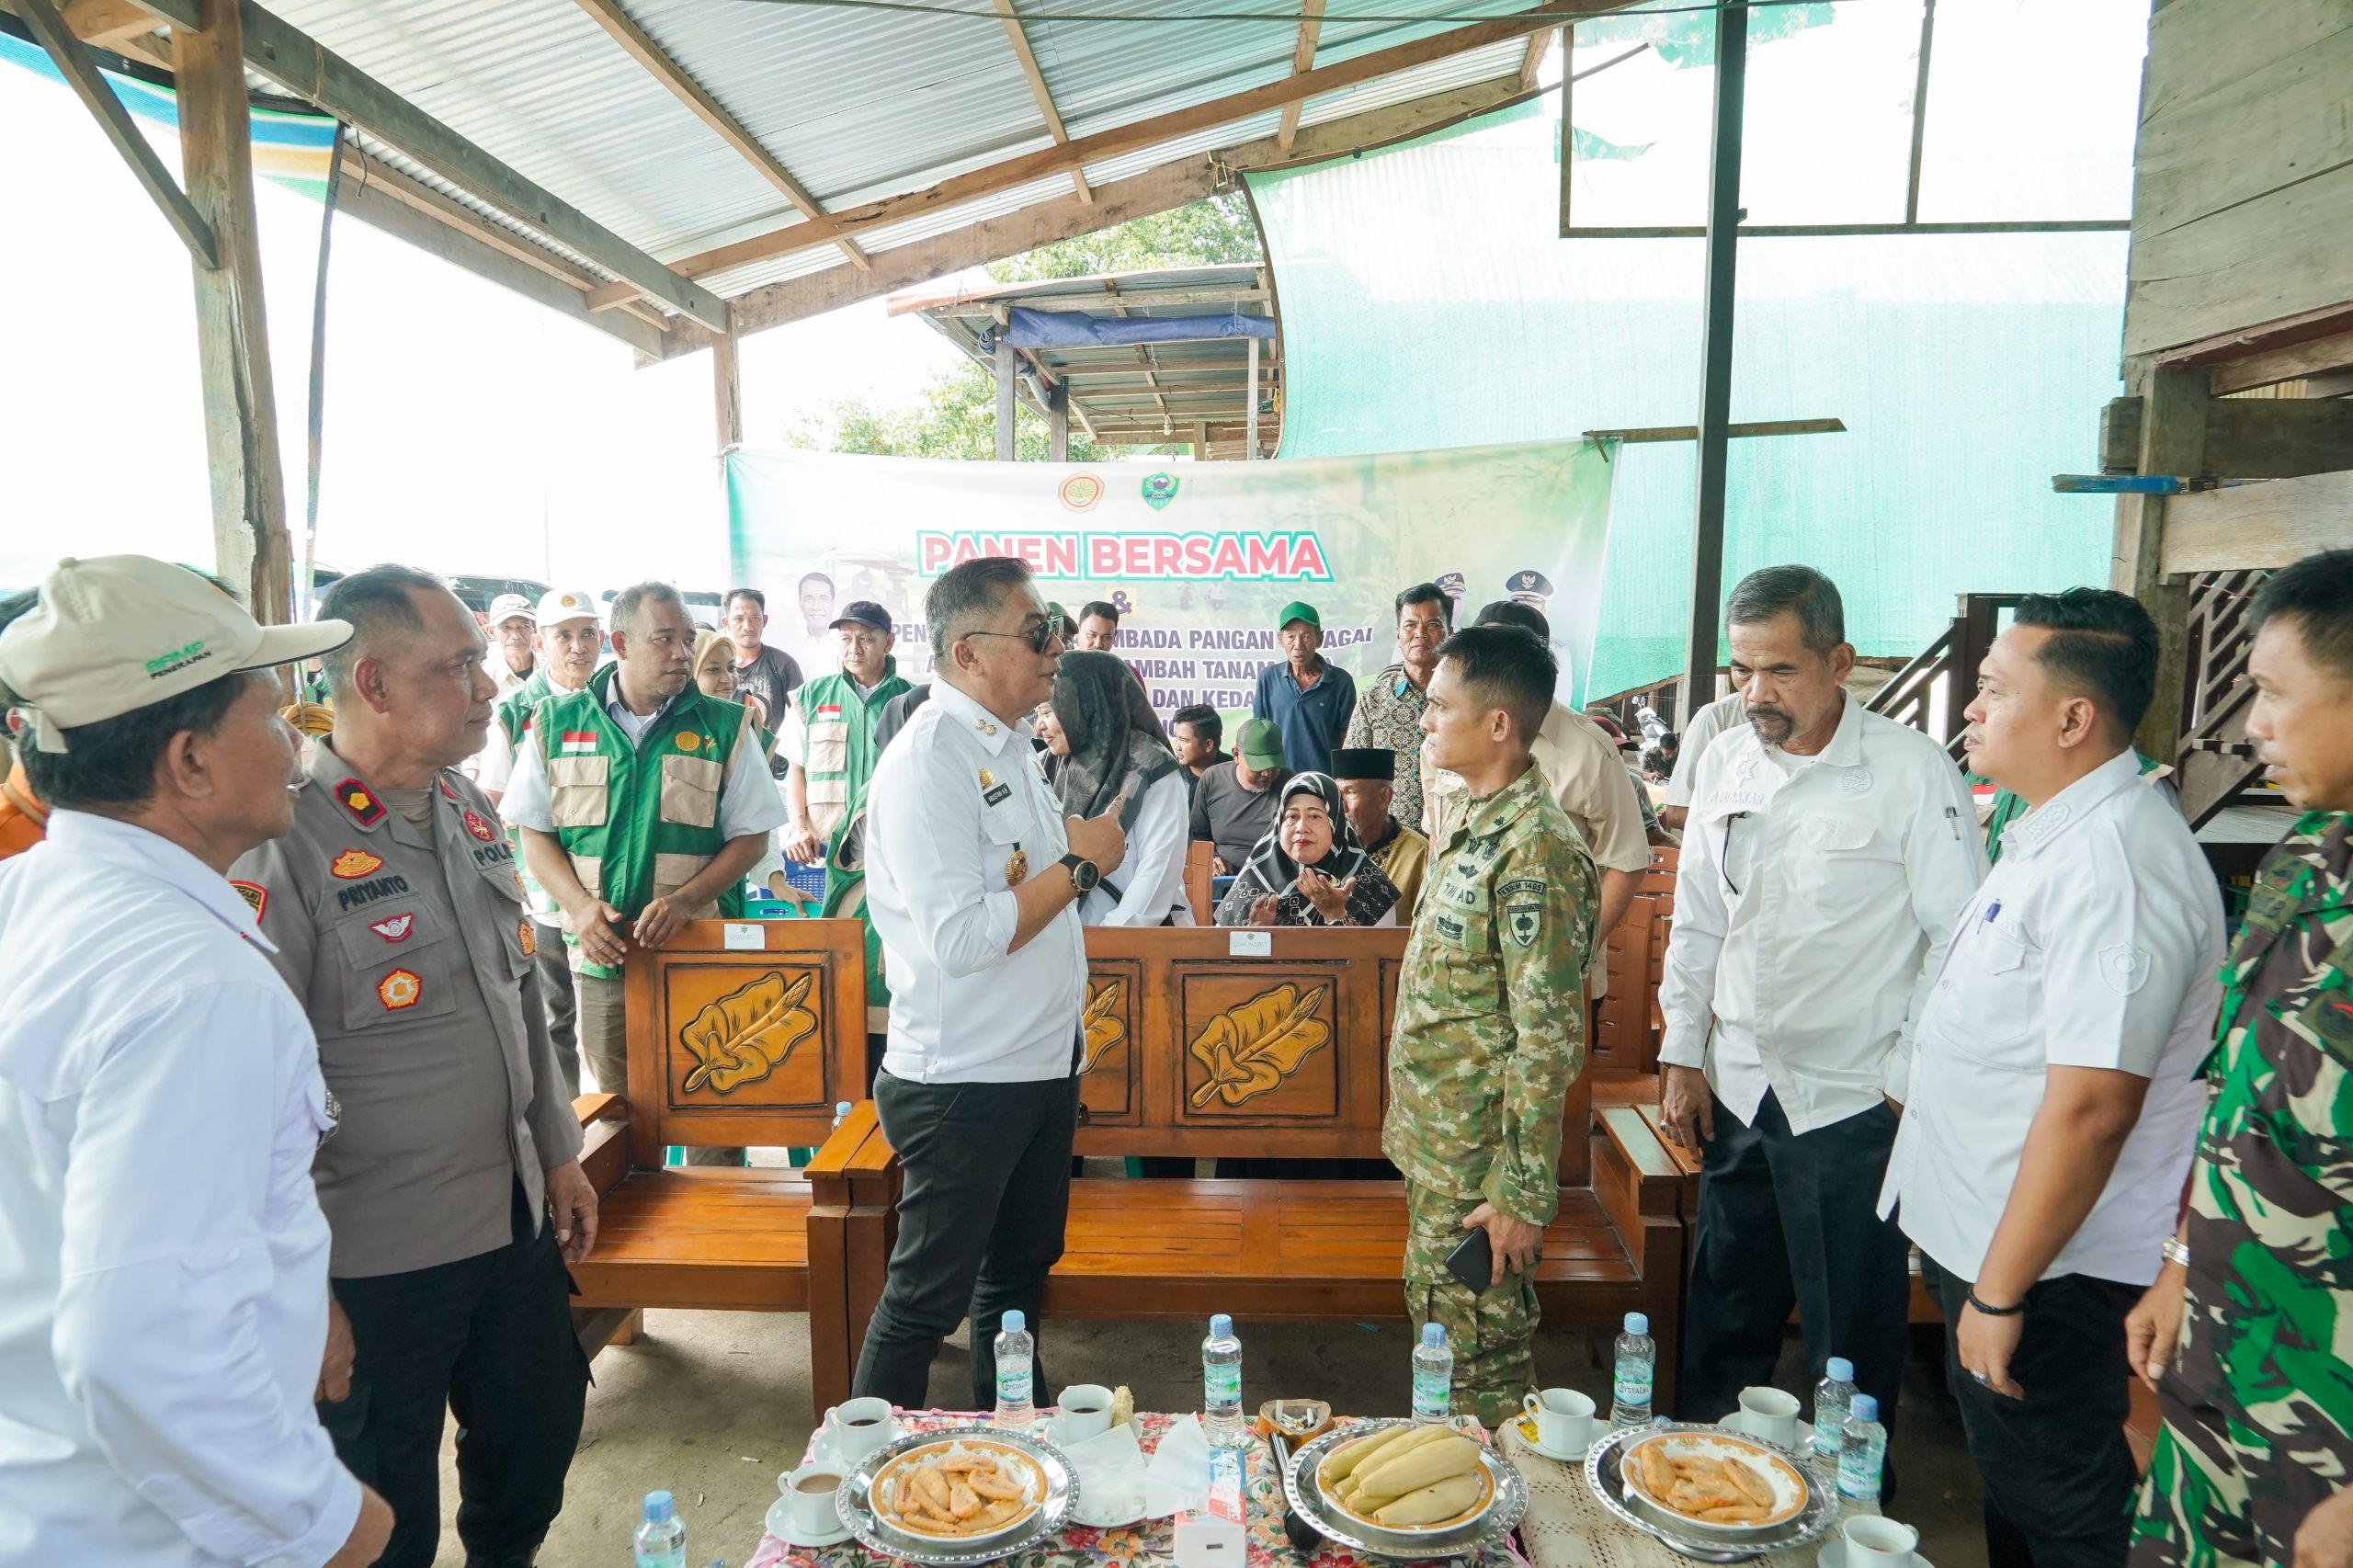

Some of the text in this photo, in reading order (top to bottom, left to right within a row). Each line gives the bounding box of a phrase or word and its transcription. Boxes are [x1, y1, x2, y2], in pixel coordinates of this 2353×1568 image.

[923, 535, 1327, 575] PANEN BERSAMA
[1110, 590, 1132, 614] &
[1189, 629, 1275, 650] PANGAN
[1323, 627, 1373, 649] AGAI
[1153, 688, 1194, 709] DAN
[1710, 790, 1765, 805] ABUBAKAR
[336, 874, 410, 912] PRIYANTO
[1456, 887, 1476, 905] AD
